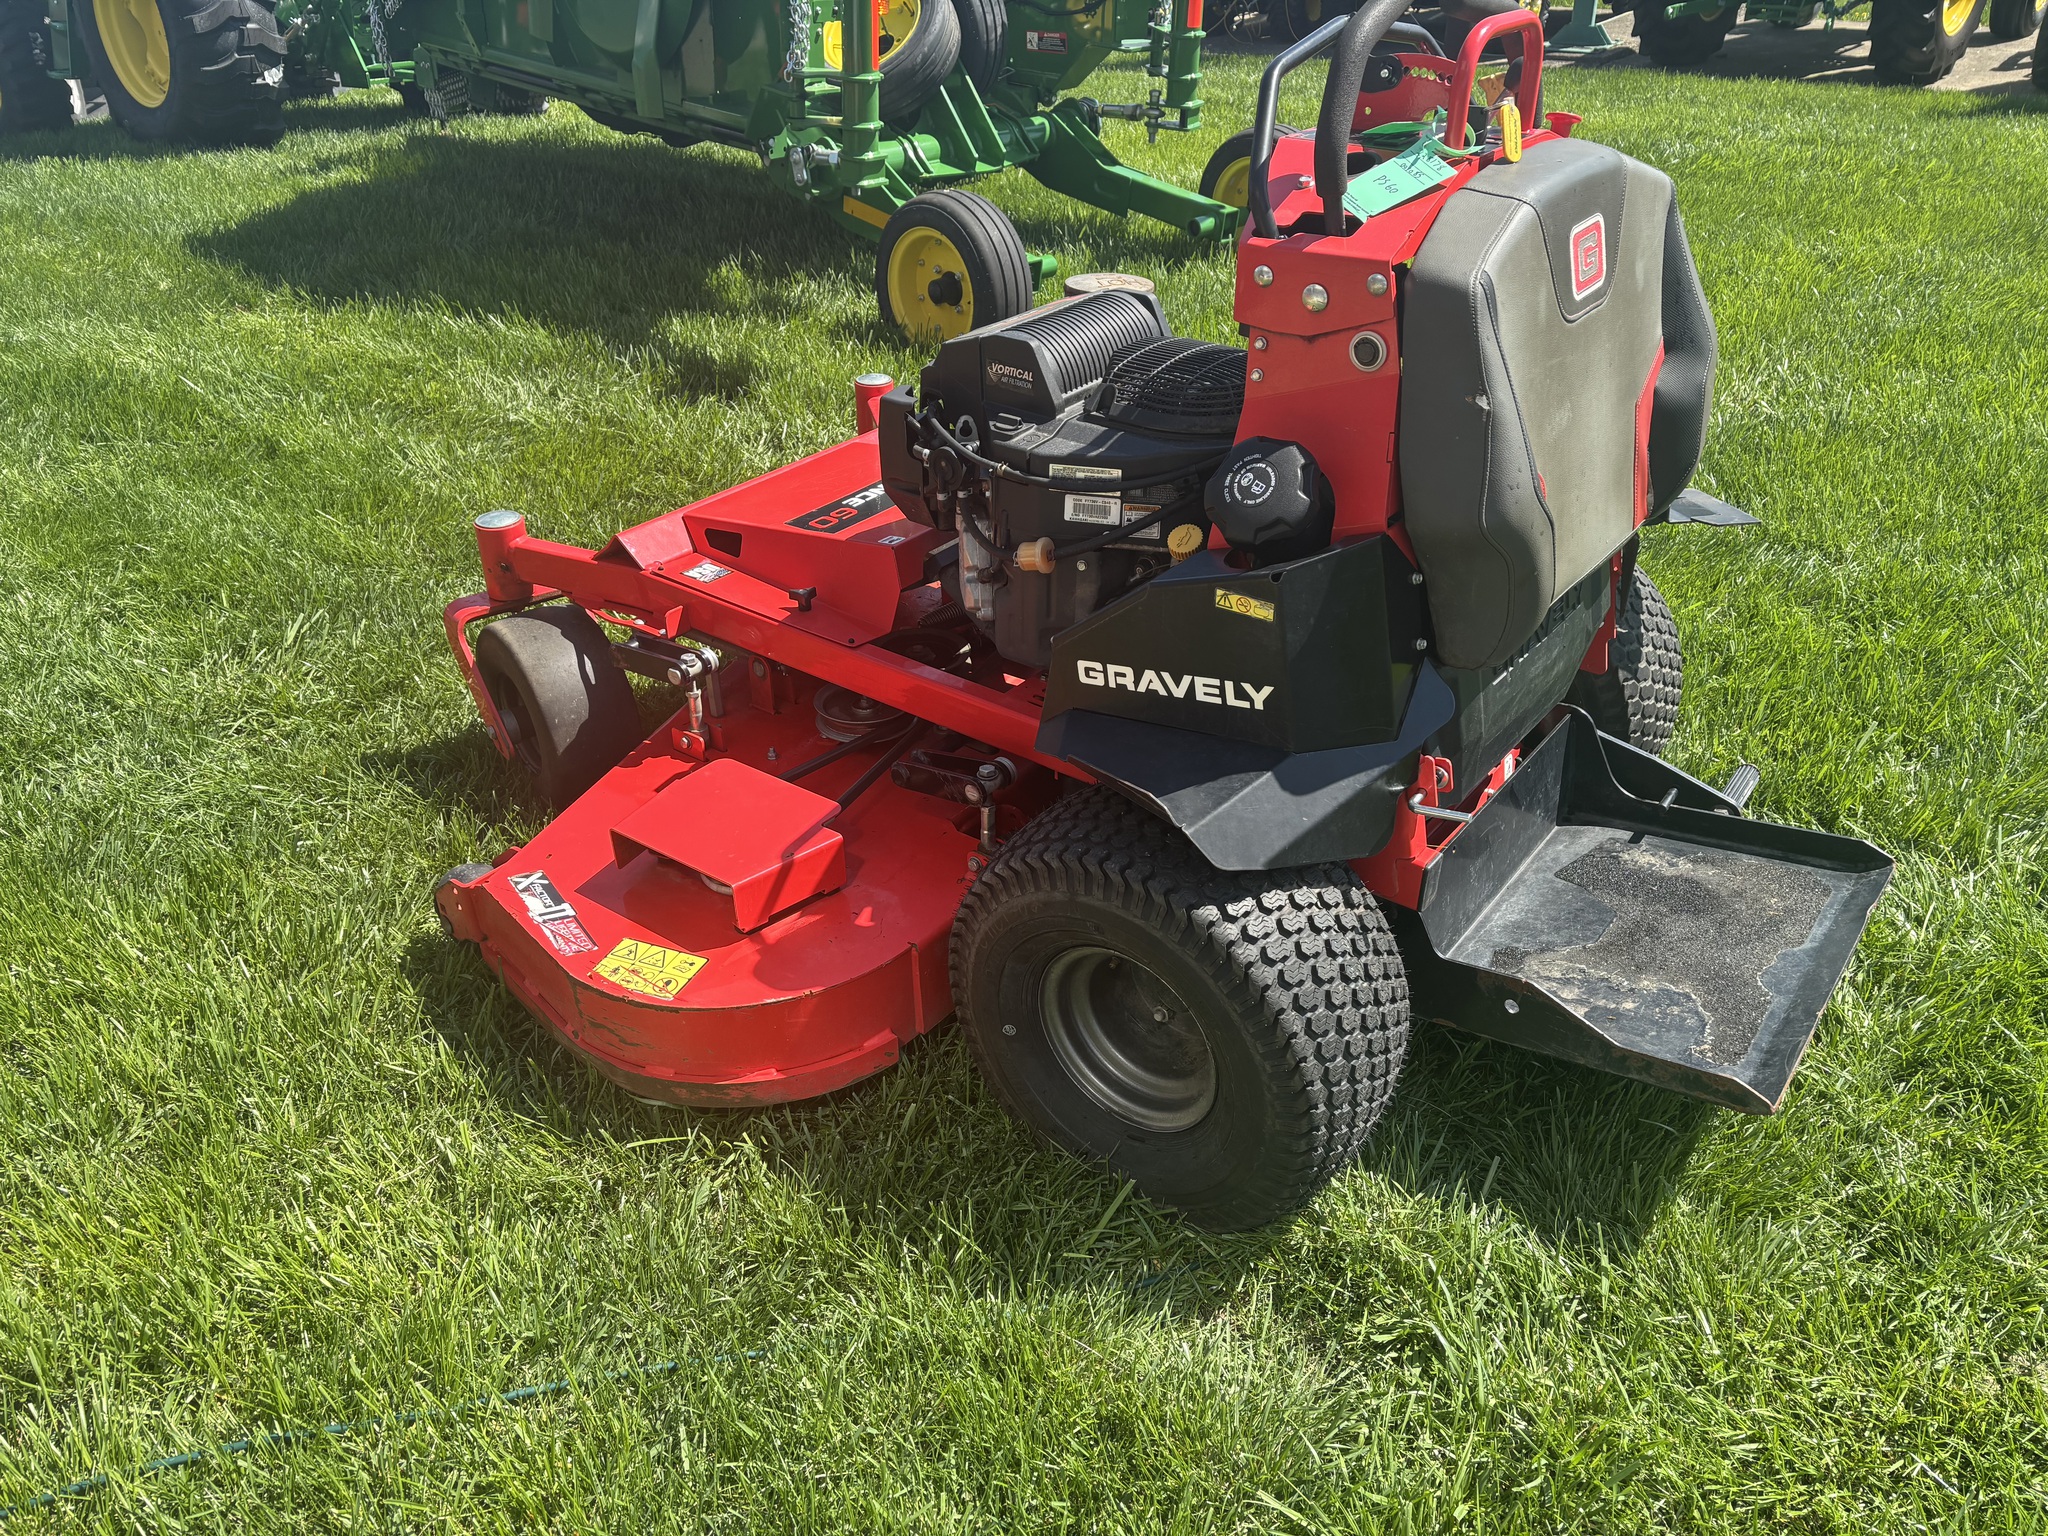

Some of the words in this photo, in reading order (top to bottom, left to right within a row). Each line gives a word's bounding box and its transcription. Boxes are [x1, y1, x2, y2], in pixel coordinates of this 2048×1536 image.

[1578, 230, 1599, 282] G
[992, 362, 1034, 382] VORTICAL
[1000, 376, 1009, 384] AIR
[1009, 378, 1033, 390] FILTRATION
[1232, 460, 1243, 472] PAST
[1224, 472, 1234, 487] THREE
[808, 507, 859, 529] 60
[1077, 659, 1275, 710] GRAVELY
[563, 916, 593, 951] LIMITED
